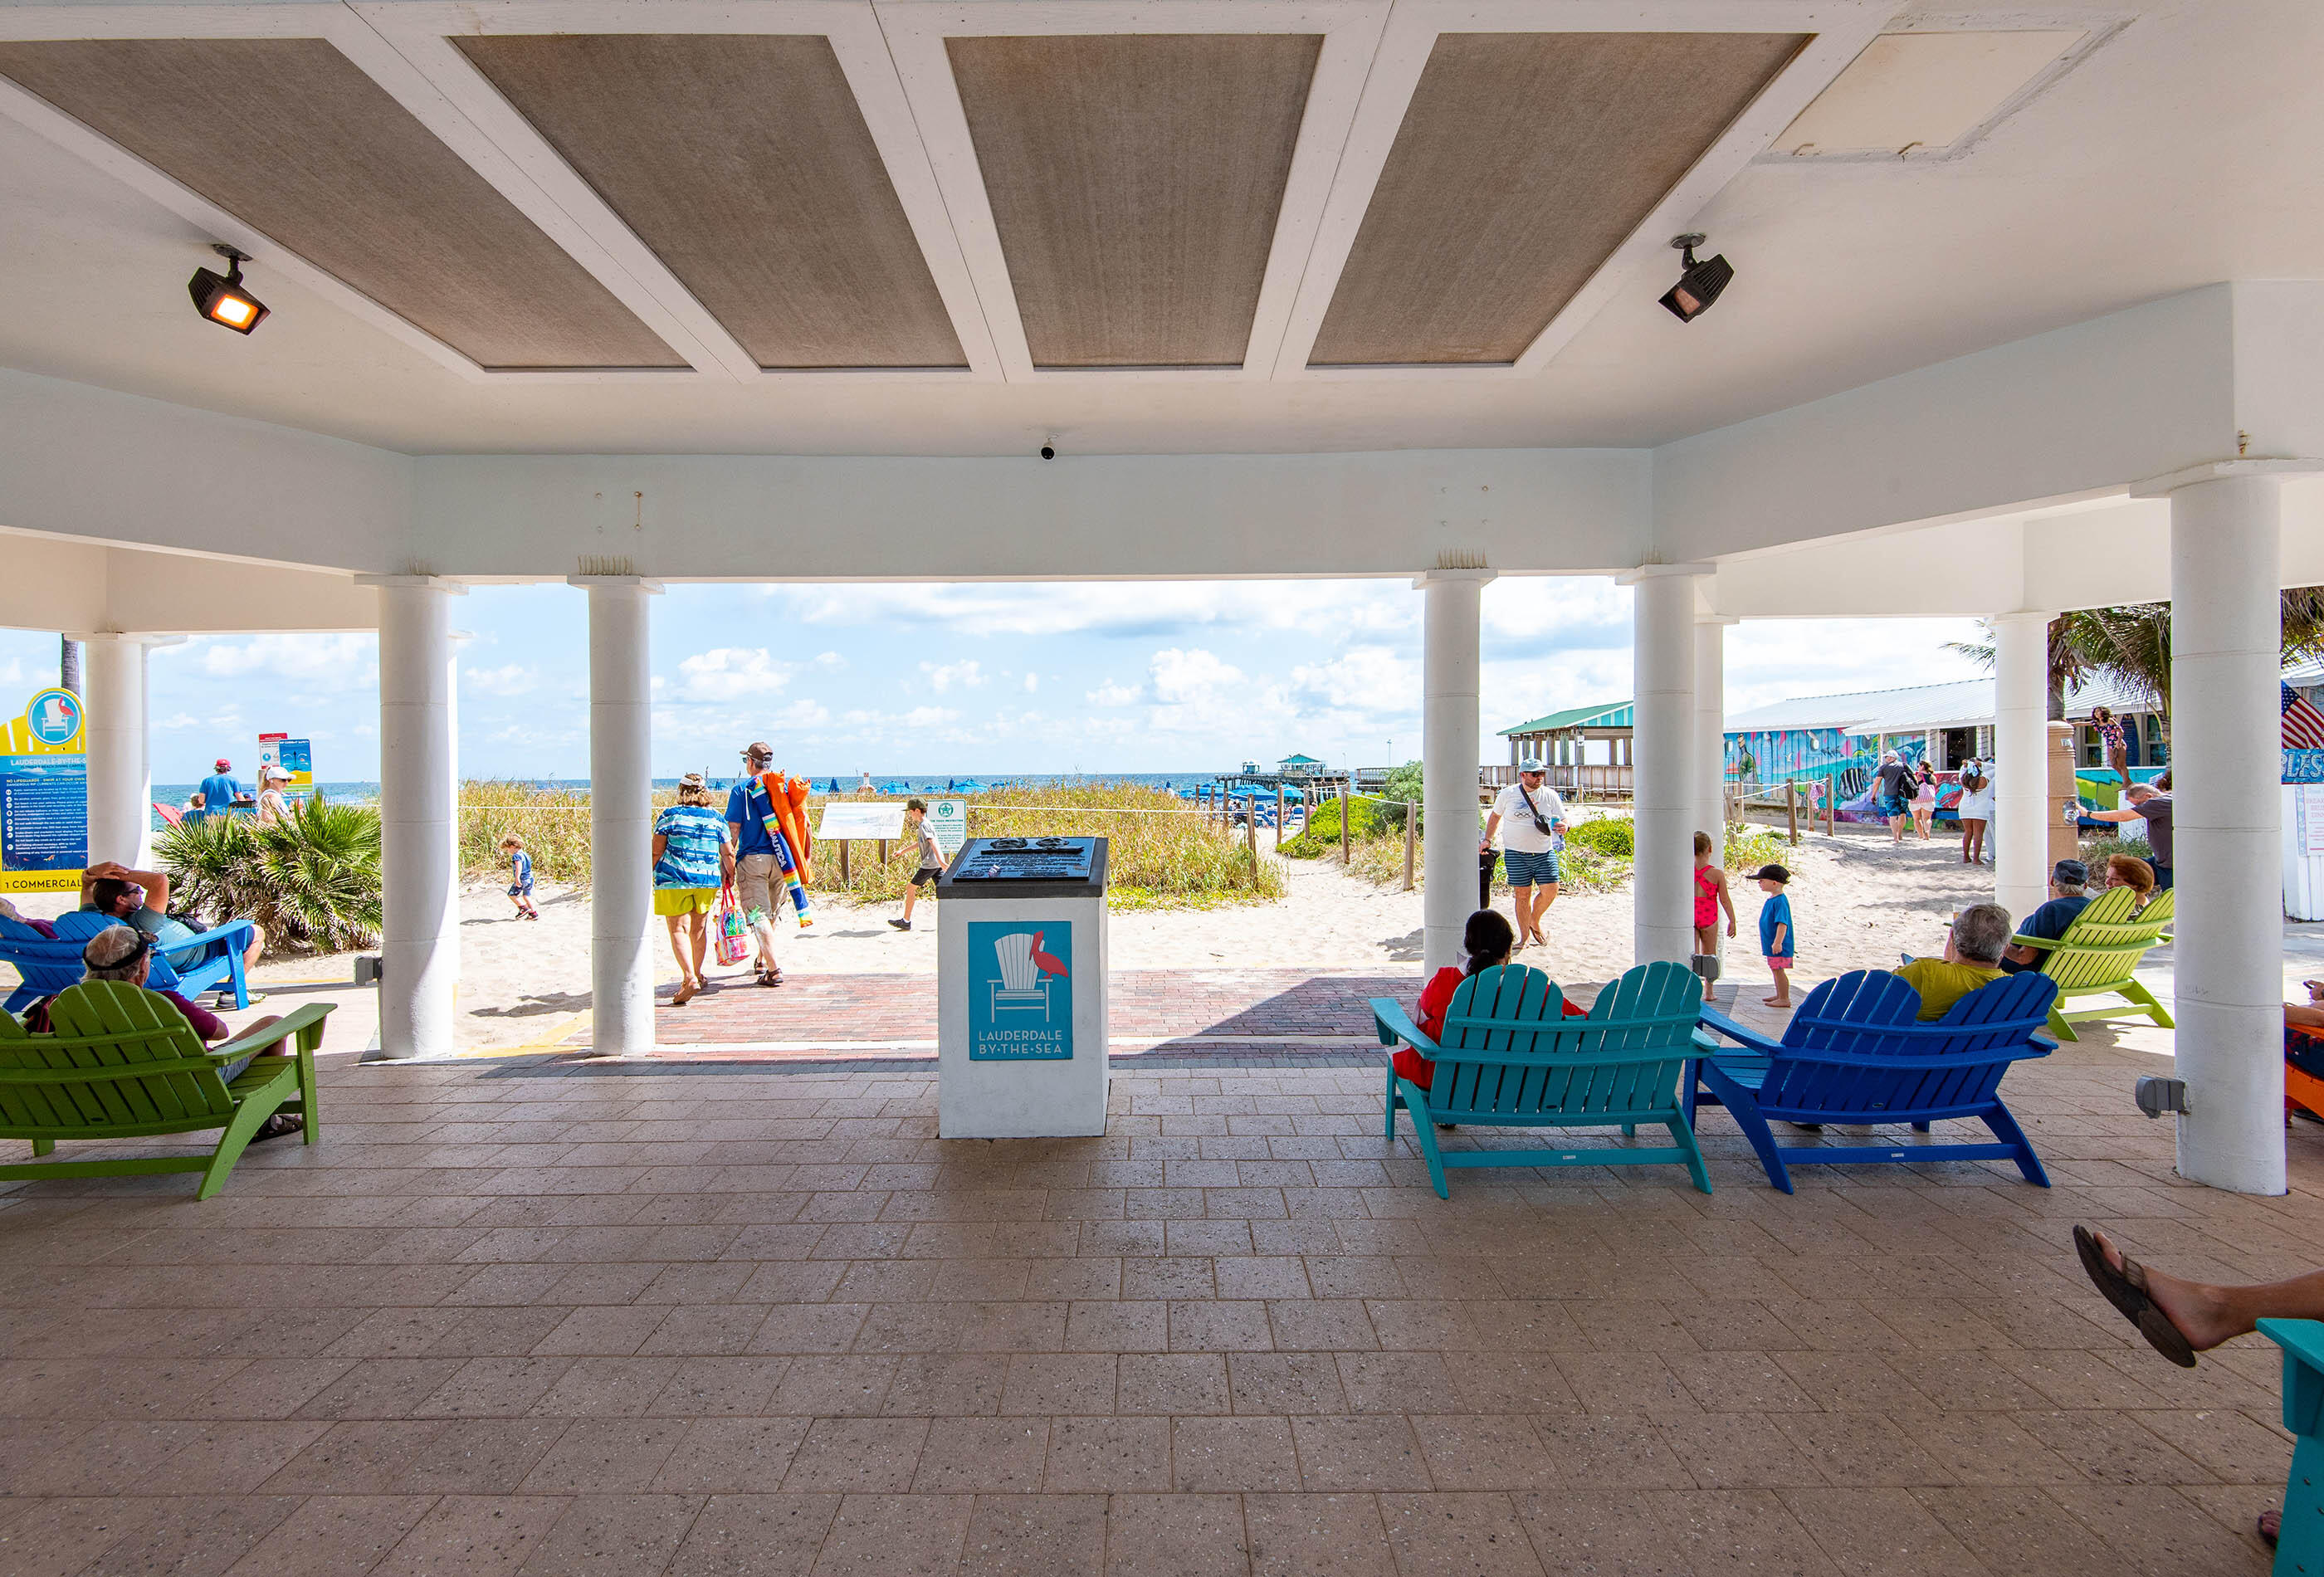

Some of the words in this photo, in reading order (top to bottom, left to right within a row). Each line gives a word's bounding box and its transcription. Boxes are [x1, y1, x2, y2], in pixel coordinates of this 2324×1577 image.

[2281, 754, 2324, 778] BLES
[769, 828, 787, 867] NAUTICA
[12, 879, 82, 889] COMMERCIAL
[979, 1030, 1062, 1041] LAUDERDALE
